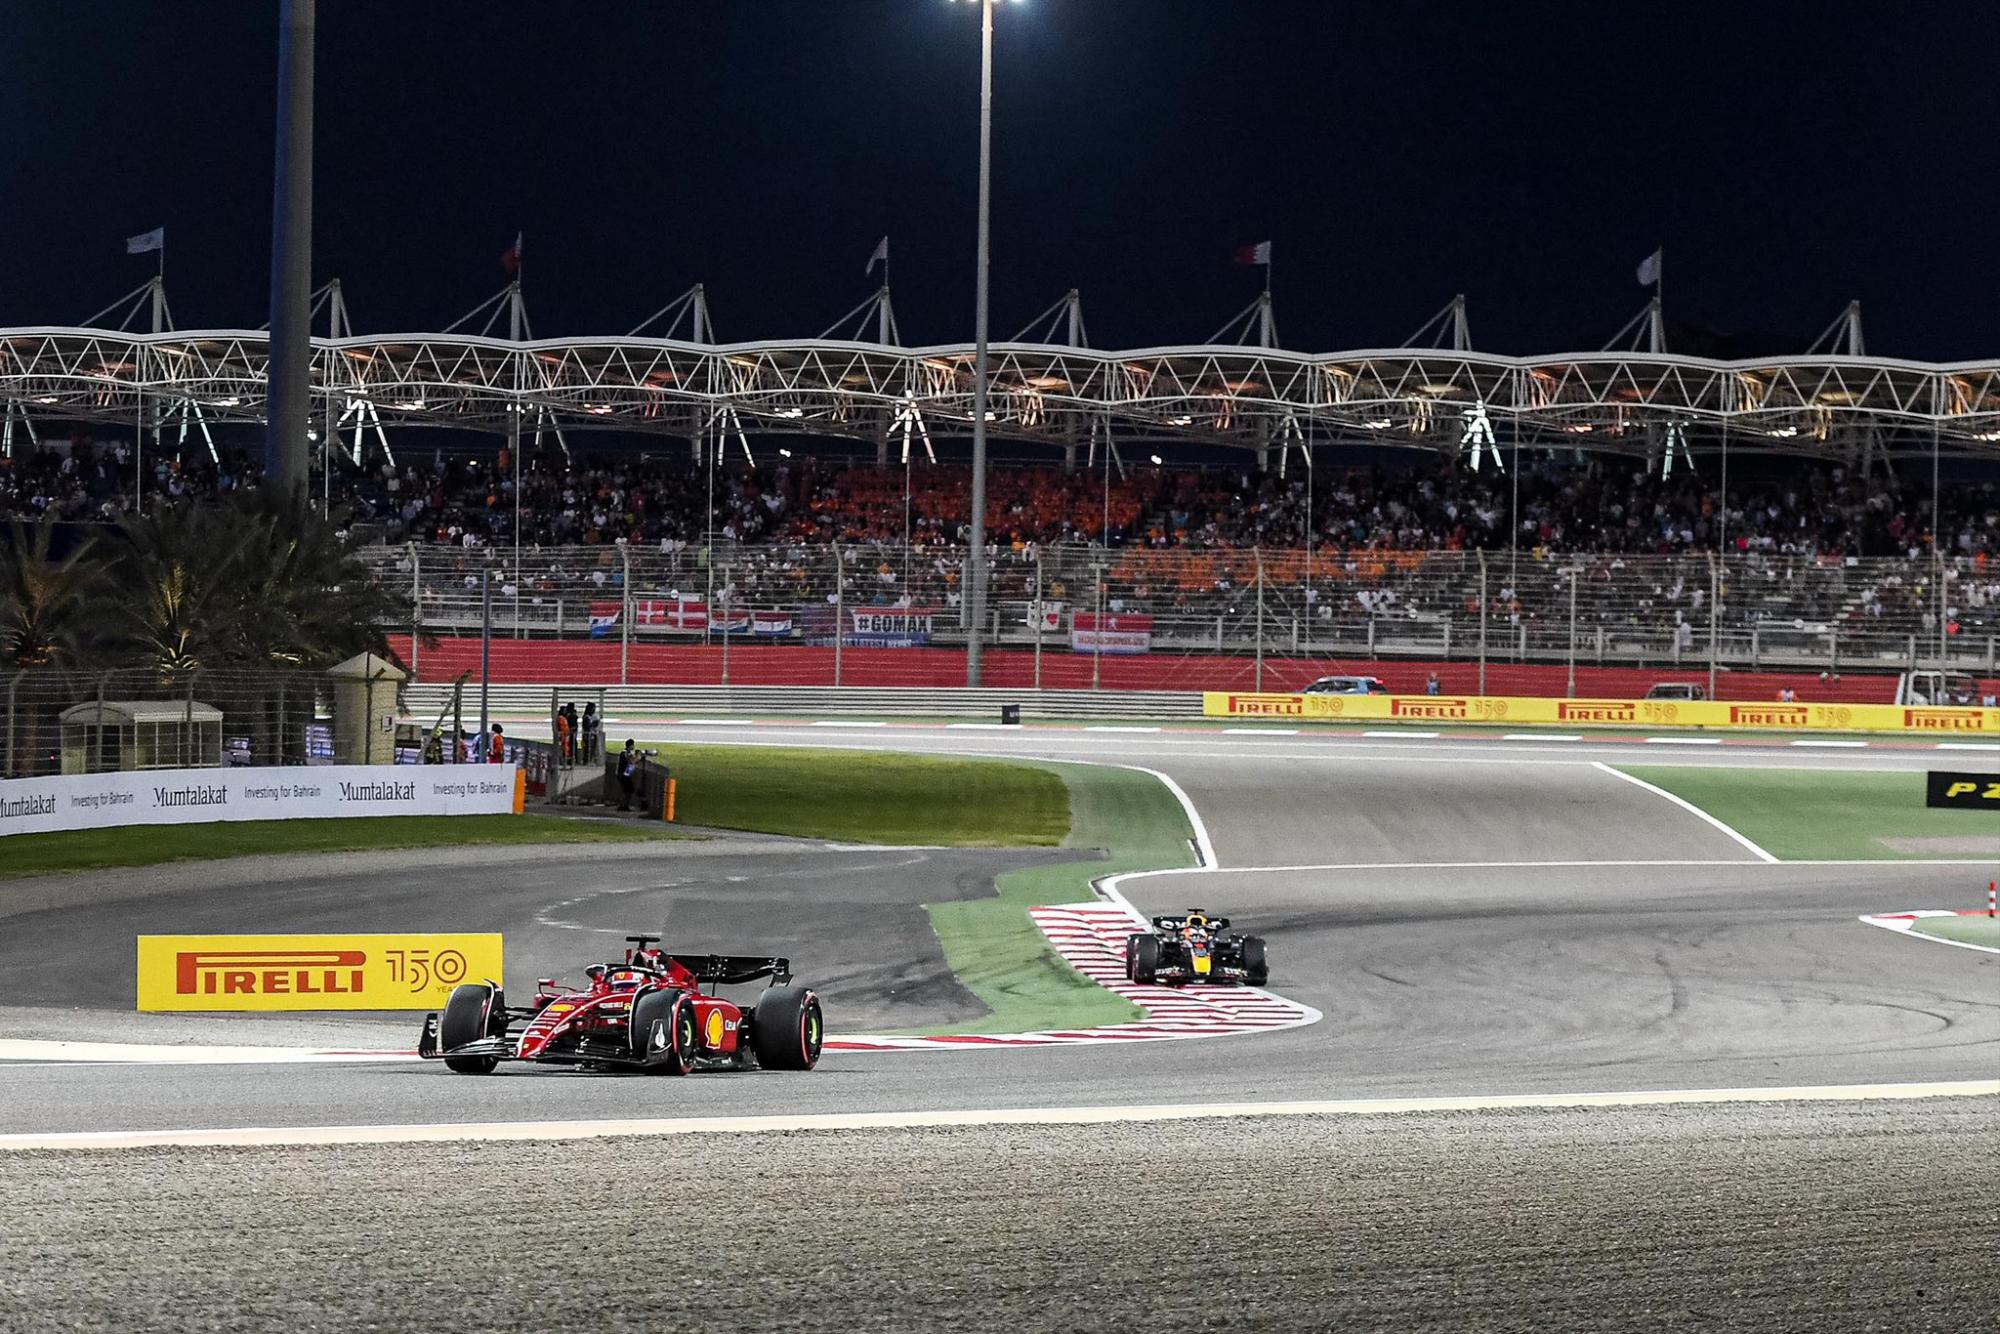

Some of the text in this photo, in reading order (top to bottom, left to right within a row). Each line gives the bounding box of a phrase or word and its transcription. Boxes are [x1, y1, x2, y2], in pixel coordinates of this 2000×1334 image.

[857, 614, 928, 632] #GOMAX
[1228, 695, 1303, 714] PIRELLI
[1391, 699, 1466, 718] PIRELLI
[1558, 702, 1636, 721] PIRELLI
[1730, 706, 1808, 725] PIRELLI
[1904, 709, 1983, 729] PIRELLI
[71, 795, 99, 810] Investing
[100, 793, 108, 806] for
[109, 791, 134, 806] Bahrain
[153, 785, 227, 807] Mumtalakat
[244, 787, 279, 801] Investing
[280, 785, 291, 798] for
[293, 784, 320, 797] Bahrain
[339, 782, 416, 801] Mumtalakat
[433, 783, 466, 798] Investing
[467, 783, 478, 795] for
[480, 781, 507, 795] Bahrain
[176, 950, 467, 994] PIRELLI 150
[436, 985, 453, 994] YEA
